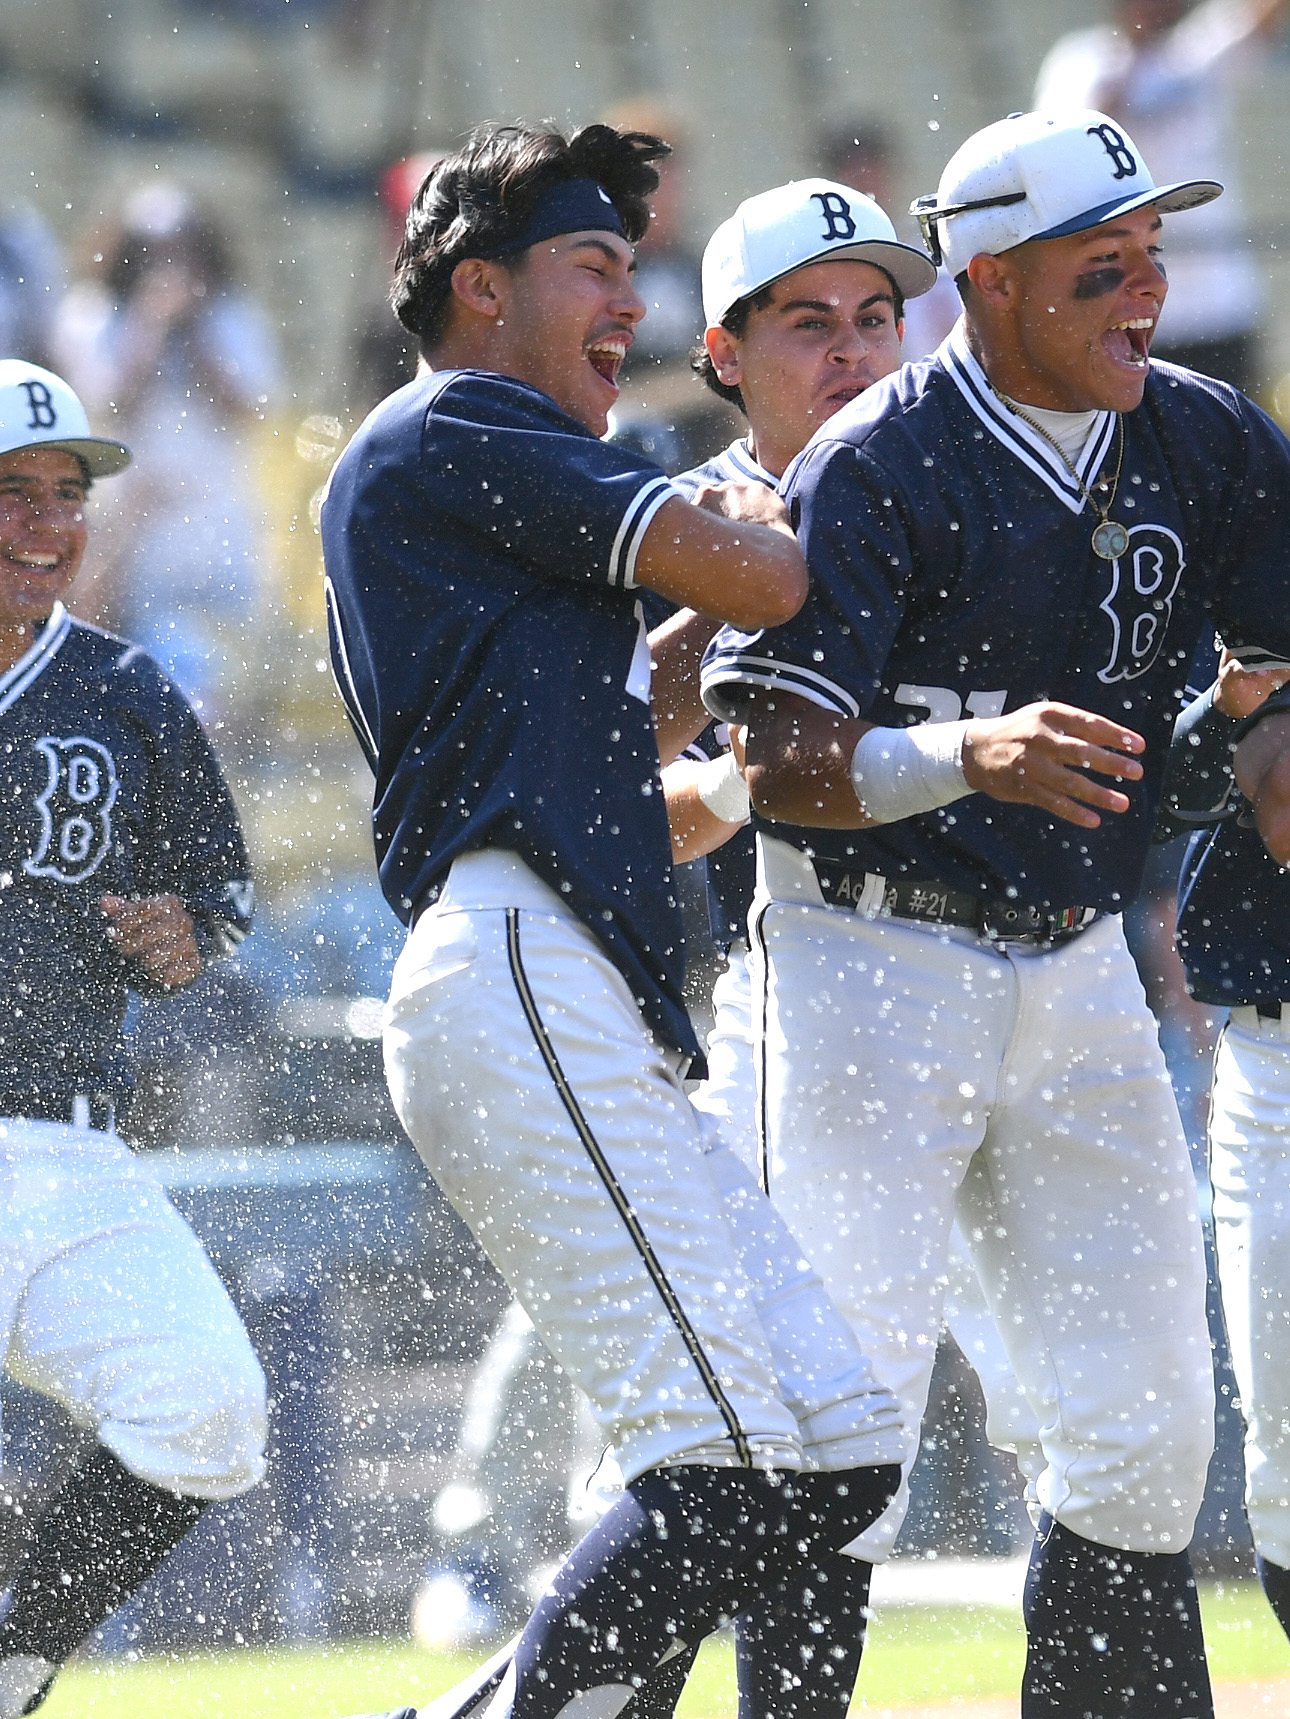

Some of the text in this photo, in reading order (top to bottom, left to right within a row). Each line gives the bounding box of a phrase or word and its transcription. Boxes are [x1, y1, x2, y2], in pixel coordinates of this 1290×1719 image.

[1087, 124, 1137, 180] B
[809, 192, 856, 240] B
[18, 382, 56, 428] B
[1097, 523, 1187, 684] B
[21, 736, 121, 884] B
[836, 874, 948, 917] Aca #21
